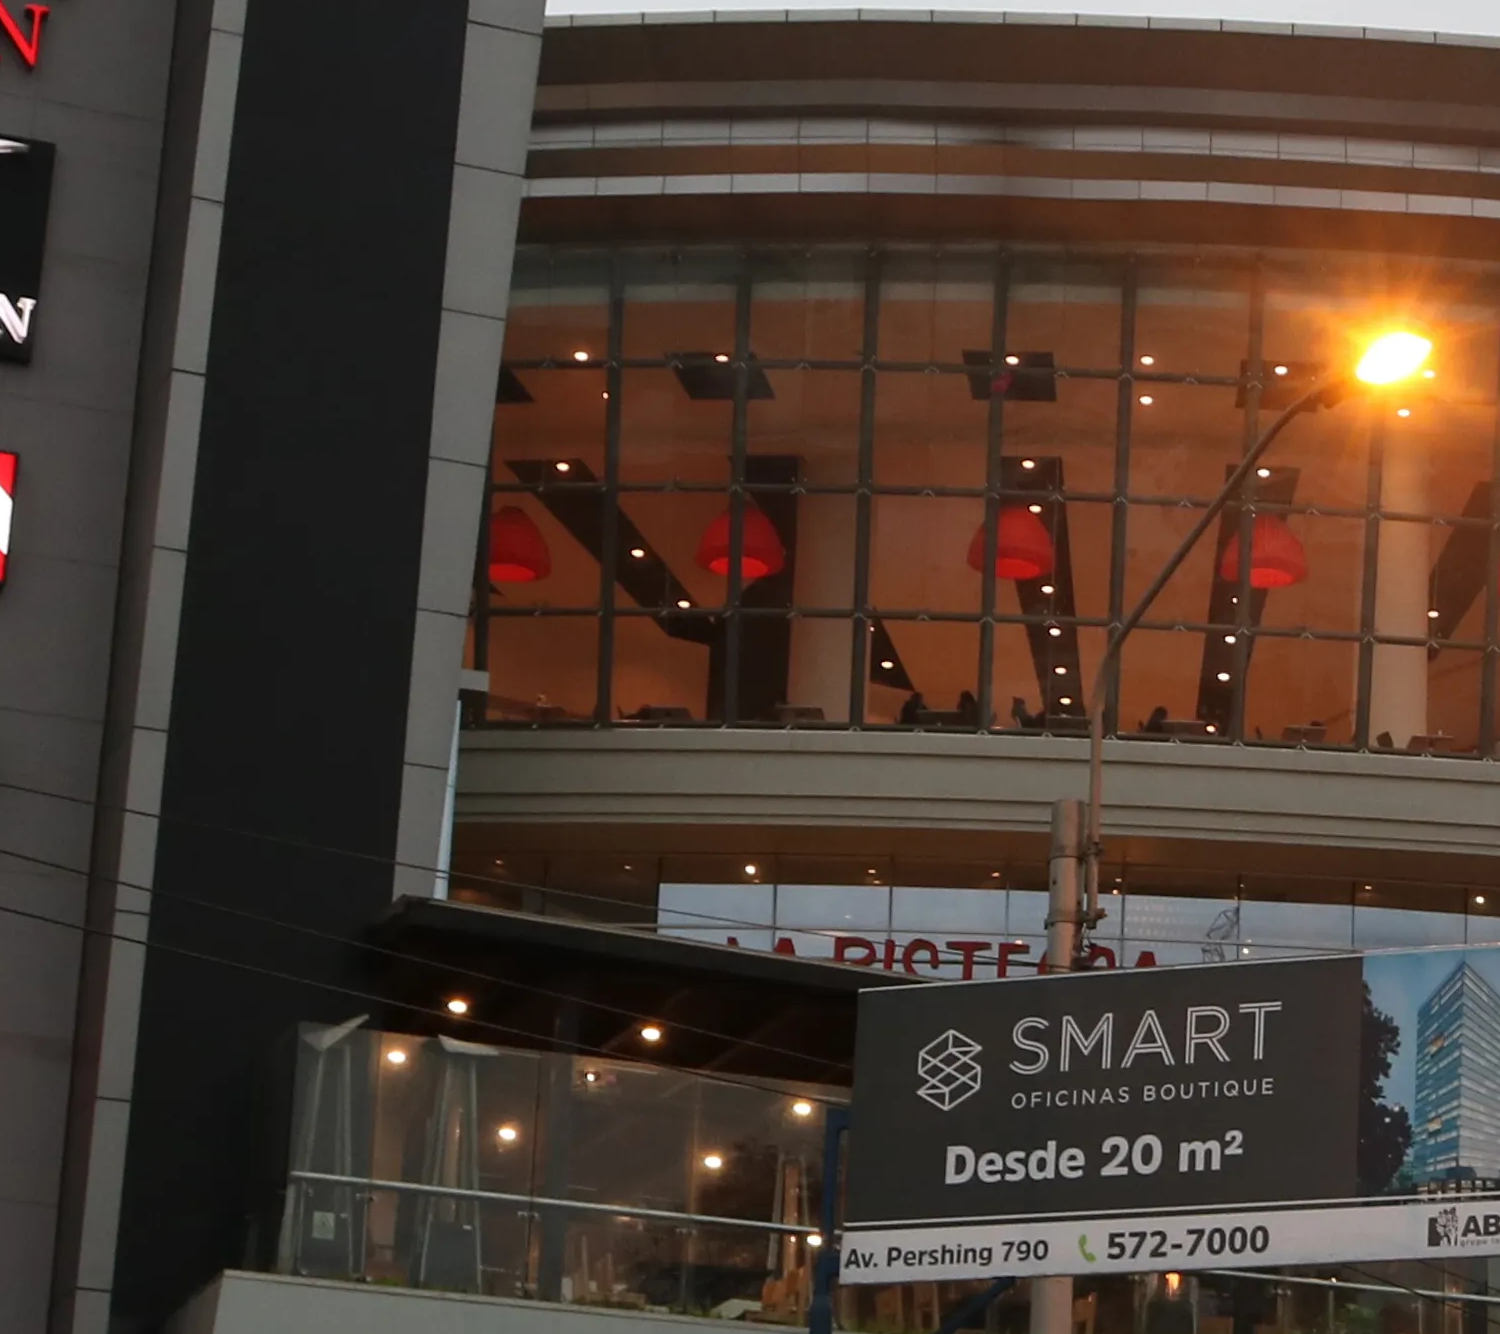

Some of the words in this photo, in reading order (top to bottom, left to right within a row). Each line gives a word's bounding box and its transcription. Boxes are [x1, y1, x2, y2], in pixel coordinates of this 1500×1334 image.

[1008, 1000, 1283, 1076] SMART
[1010, 1086, 1131, 1110] OFICINAS
[1142, 1078, 1276, 1103] BOUTIQUE
[944, 1139, 1086, 1185] Desde
[1100, 1133, 1164, 1177] 20
[843, 1247, 879, 1269] Av.
[886, 1241, 994, 1268] Pershing
[1000, 1239, 1050, 1263] 790
[1106, 1225, 1270, 1261] 572-7000
